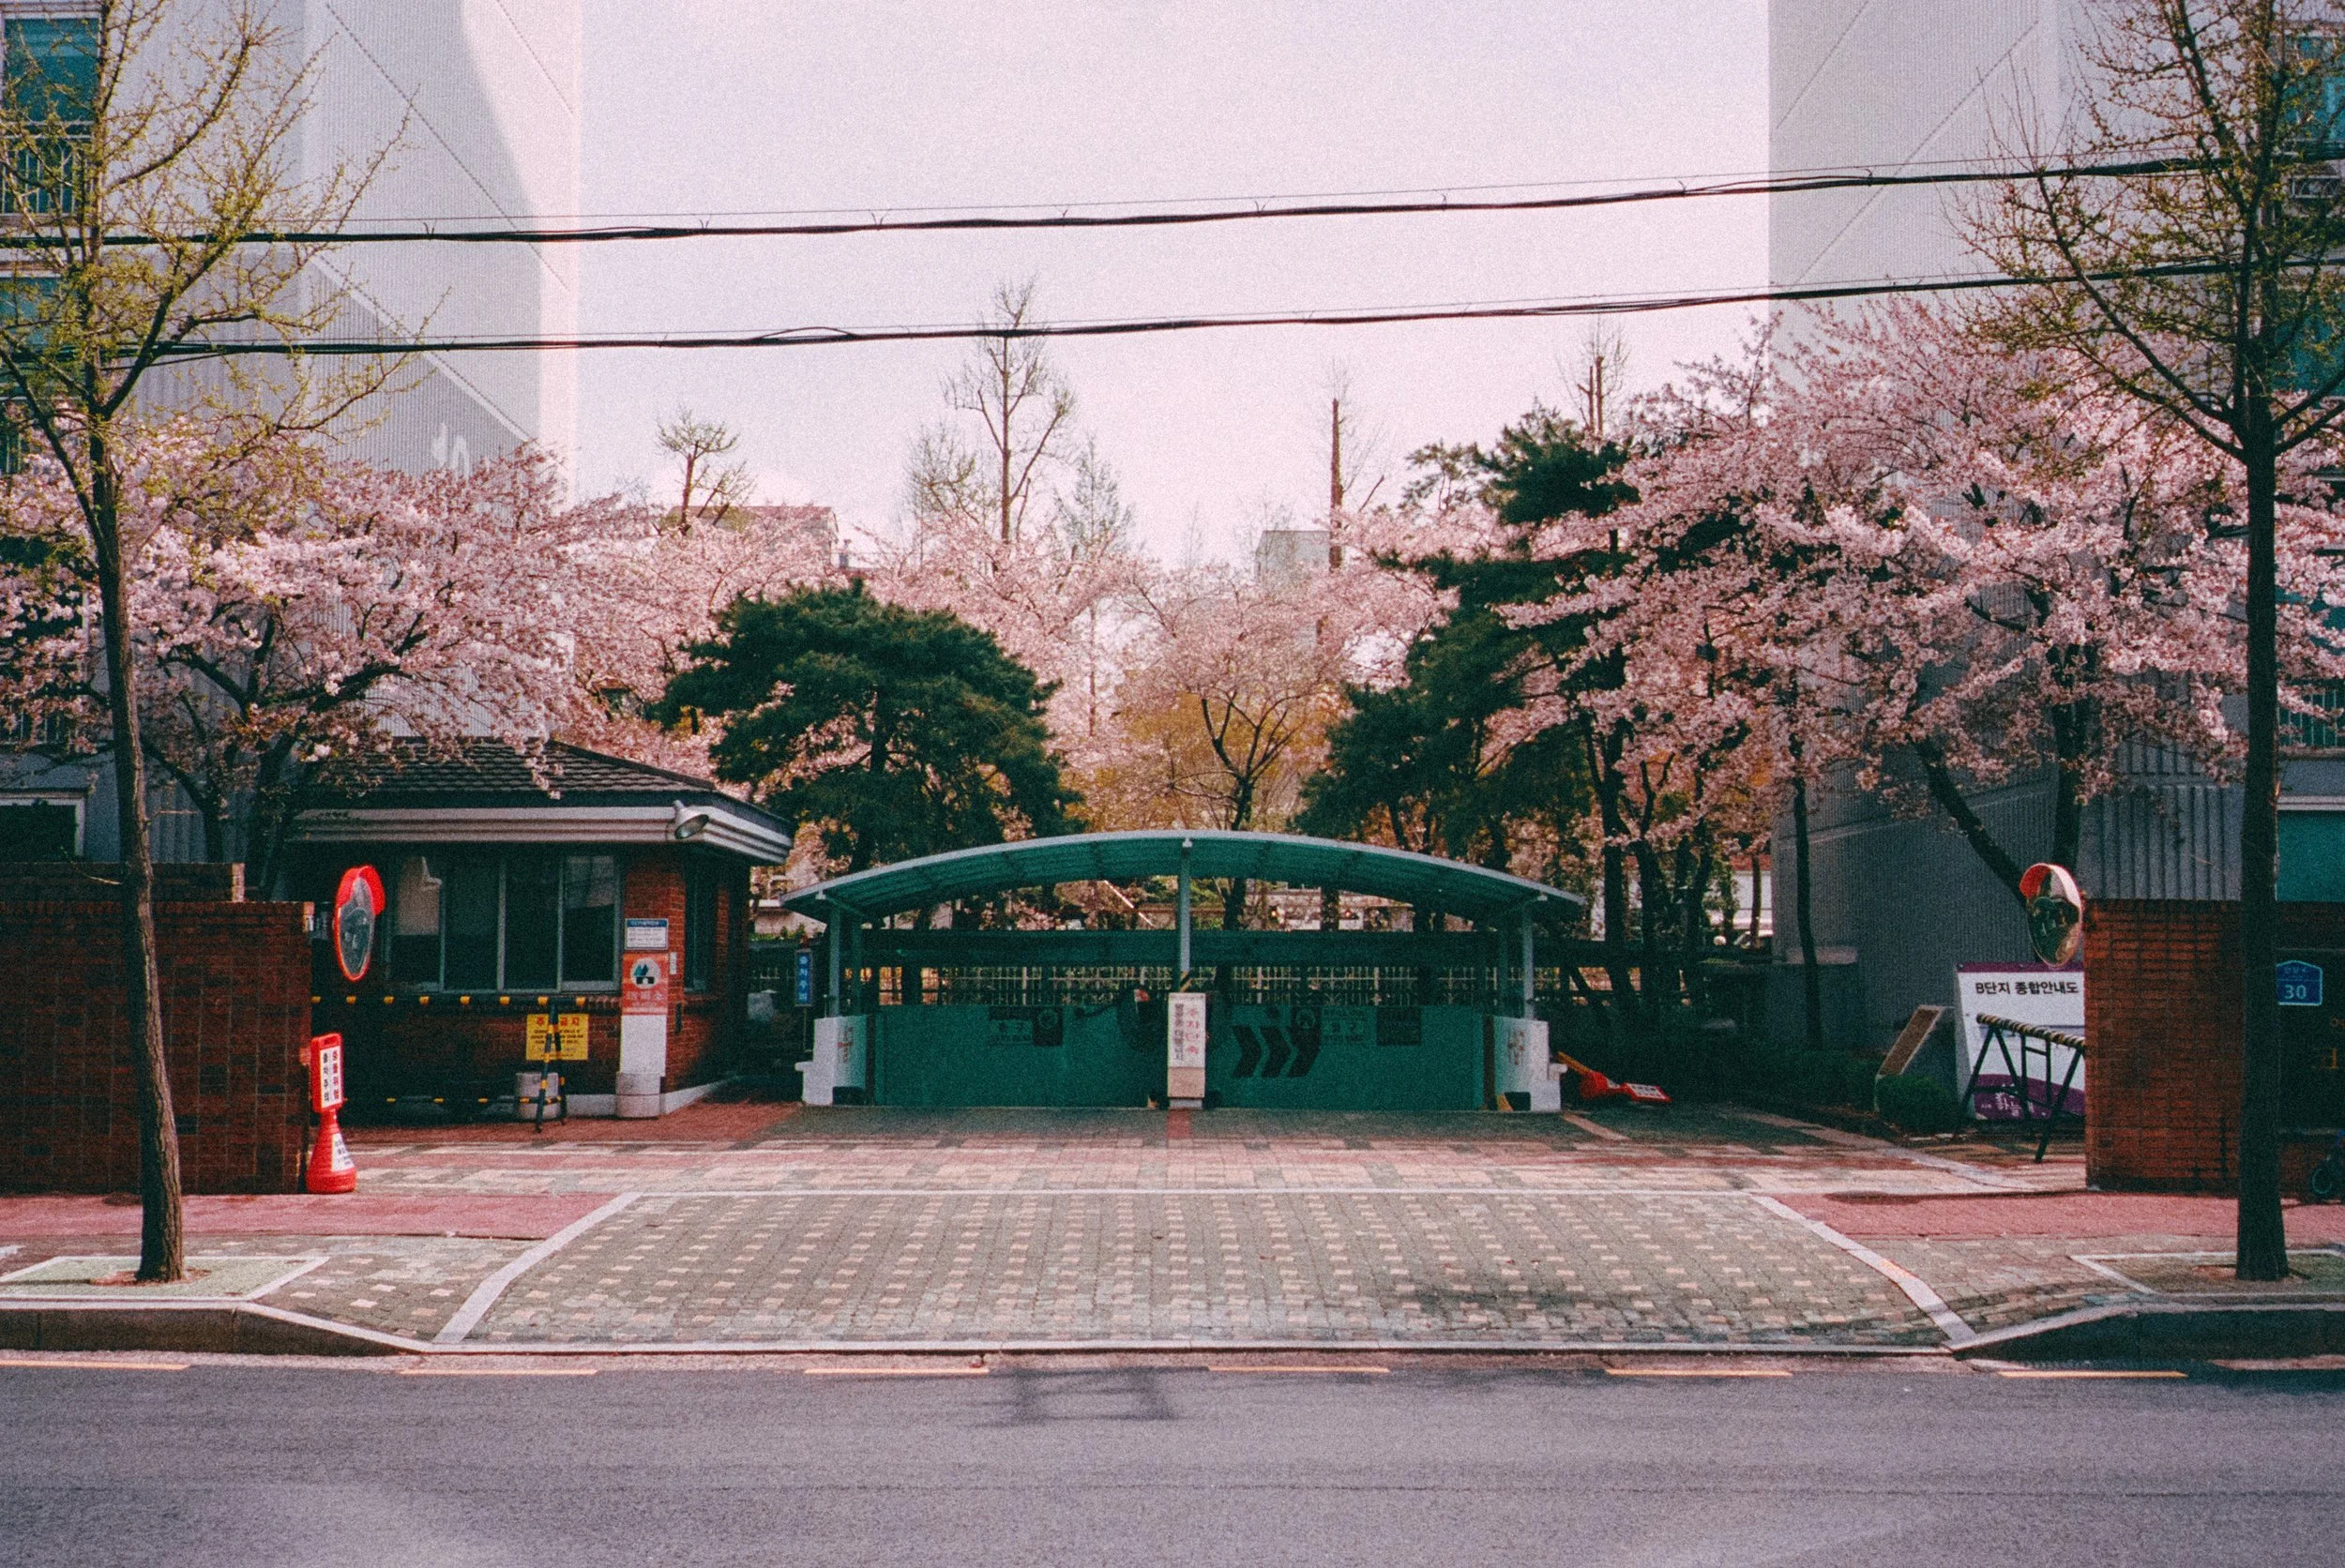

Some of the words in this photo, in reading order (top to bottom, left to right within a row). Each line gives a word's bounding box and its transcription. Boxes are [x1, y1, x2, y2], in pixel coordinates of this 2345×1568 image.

[1975, 982, 2011, 995] B단지
[2016, 981, 2080, 995] 종합안내도
[2284, 985, 2307, 1000] 30
